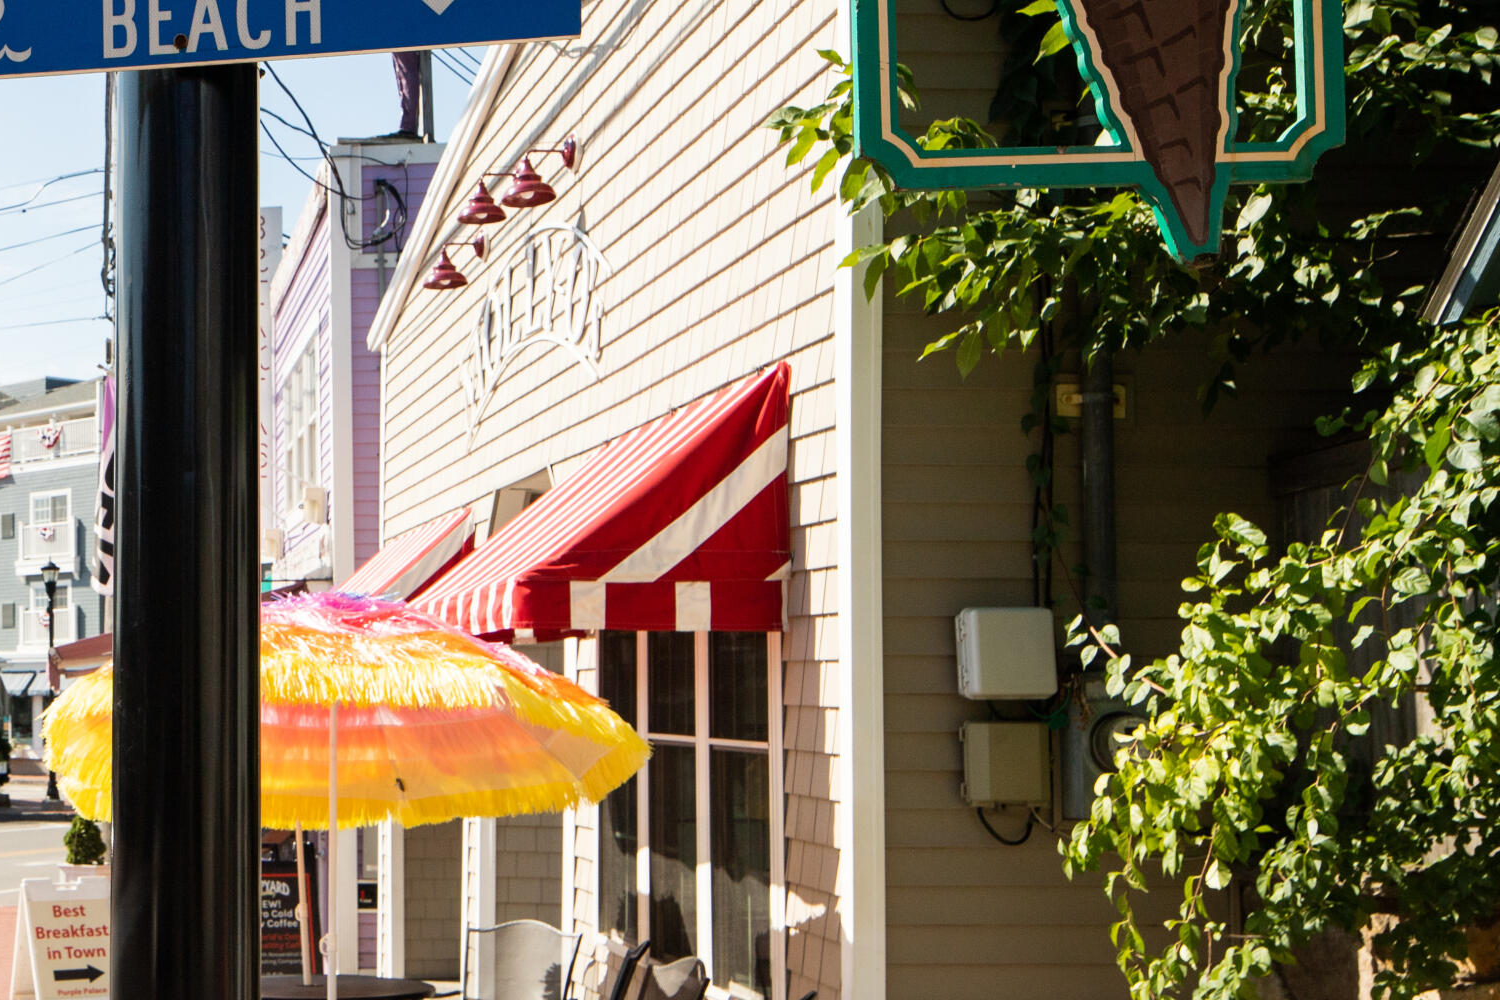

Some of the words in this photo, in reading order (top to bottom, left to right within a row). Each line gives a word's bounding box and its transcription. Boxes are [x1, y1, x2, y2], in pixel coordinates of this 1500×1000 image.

[261, 899, 282, 909] EW!
[52, 904, 86, 918] Best
[271, 908, 294, 919] Cold
[267, 918, 299, 928] Coffee
[35, 923, 109, 940] Breakfast
[47, 946, 62, 960] in
[64, 946, 107, 959] Town
